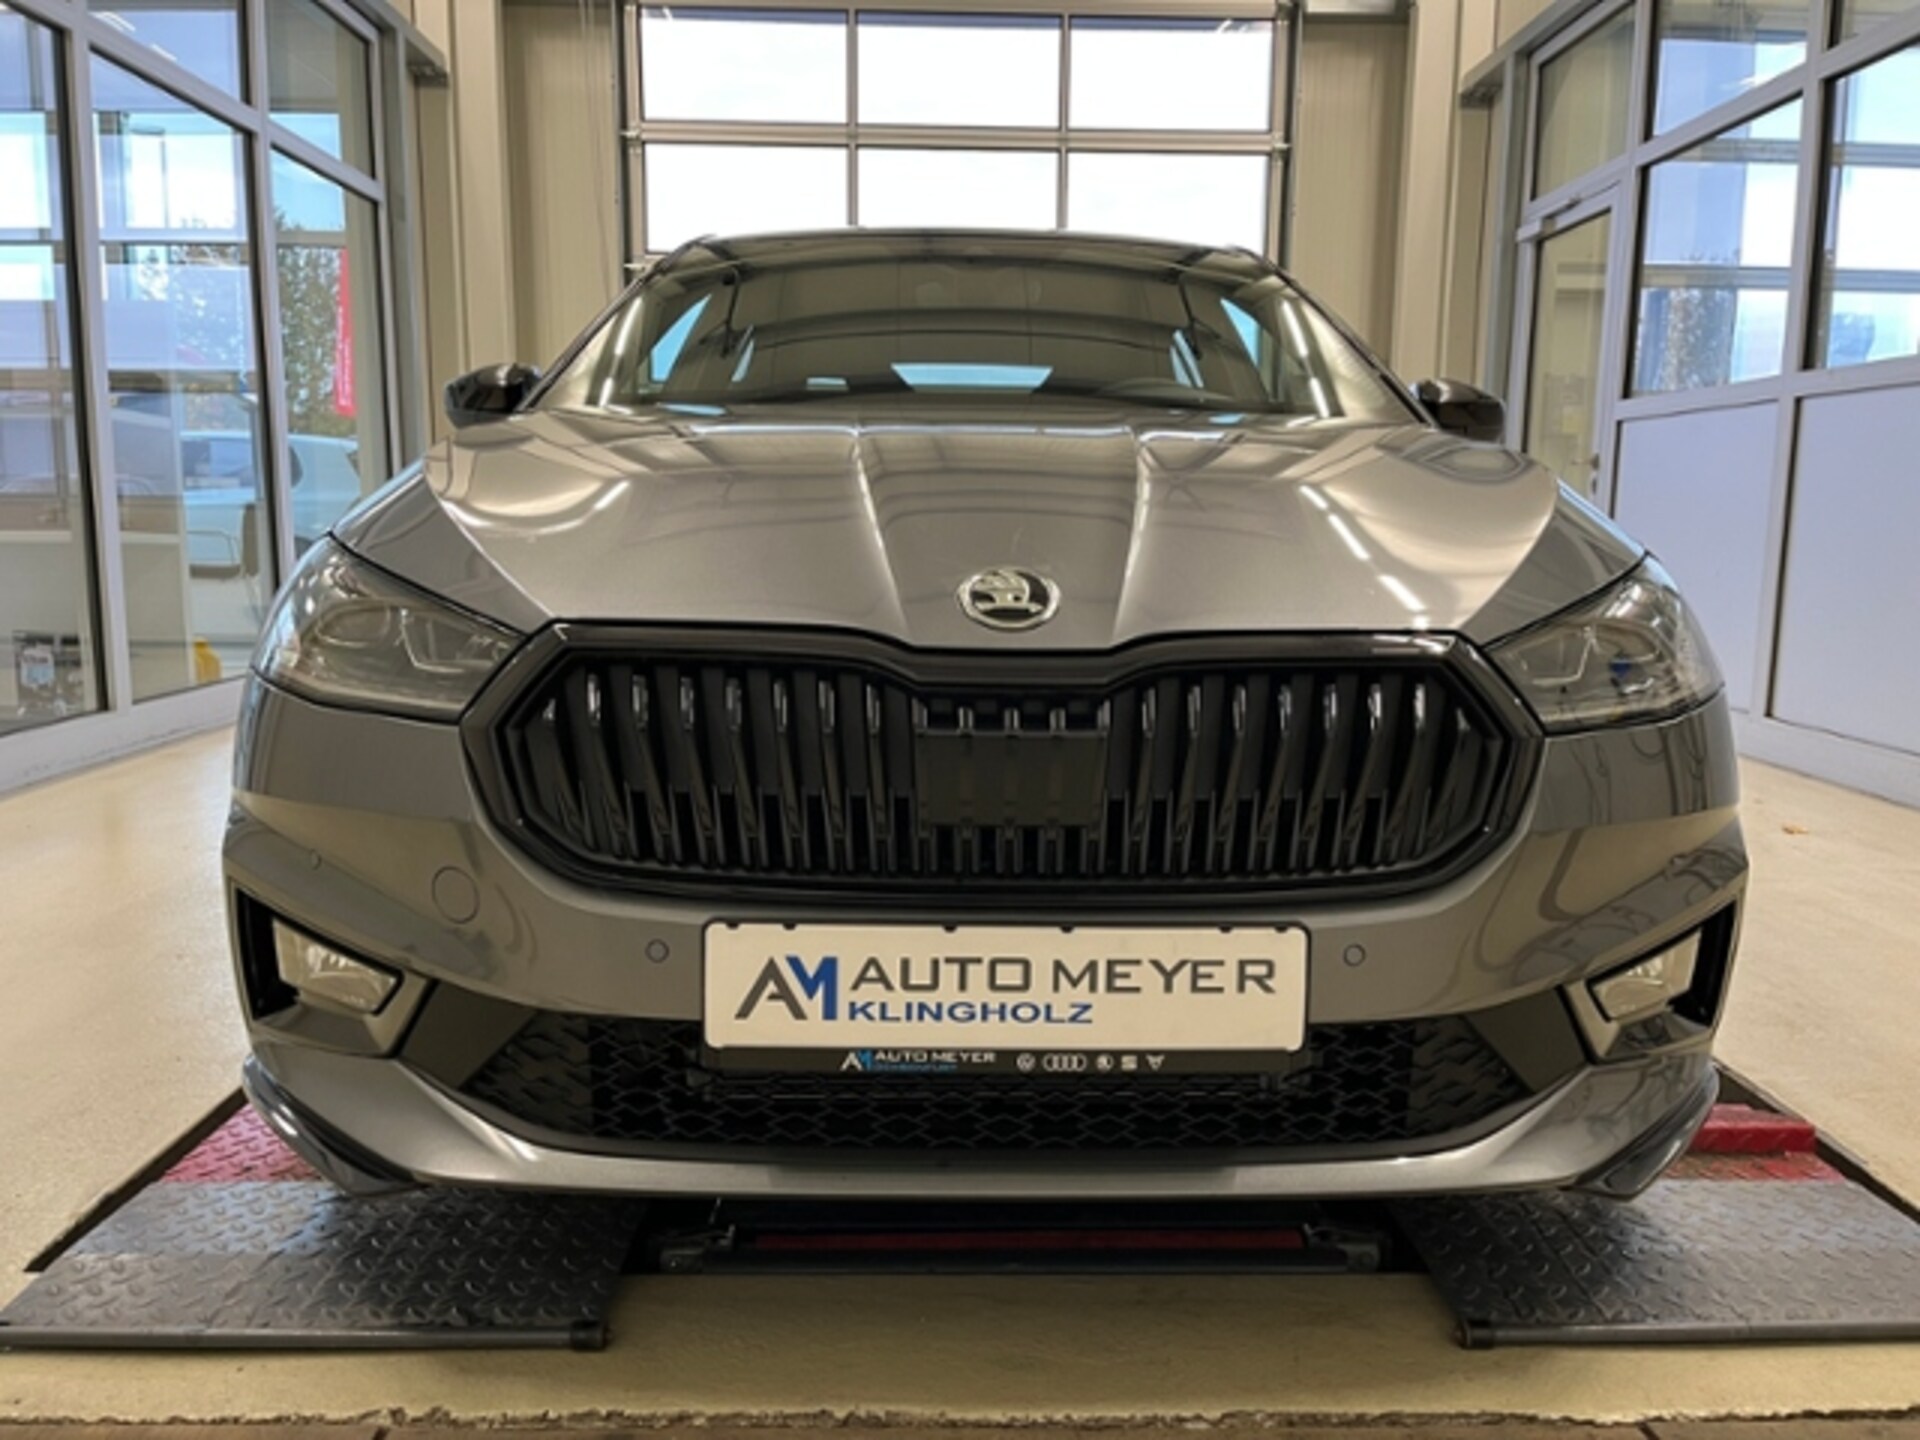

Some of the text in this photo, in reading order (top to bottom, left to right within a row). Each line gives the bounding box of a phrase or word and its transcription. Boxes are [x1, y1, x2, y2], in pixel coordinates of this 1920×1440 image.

[850, 957, 1032, 993] AUTO
[1052, 958, 1277, 994] MEYER
[848, 1001, 1093, 1024] KLINGHOLZ
[875, 1051, 928, 1062] AUTO
[932, 1052, 997, 1063] MEYER
